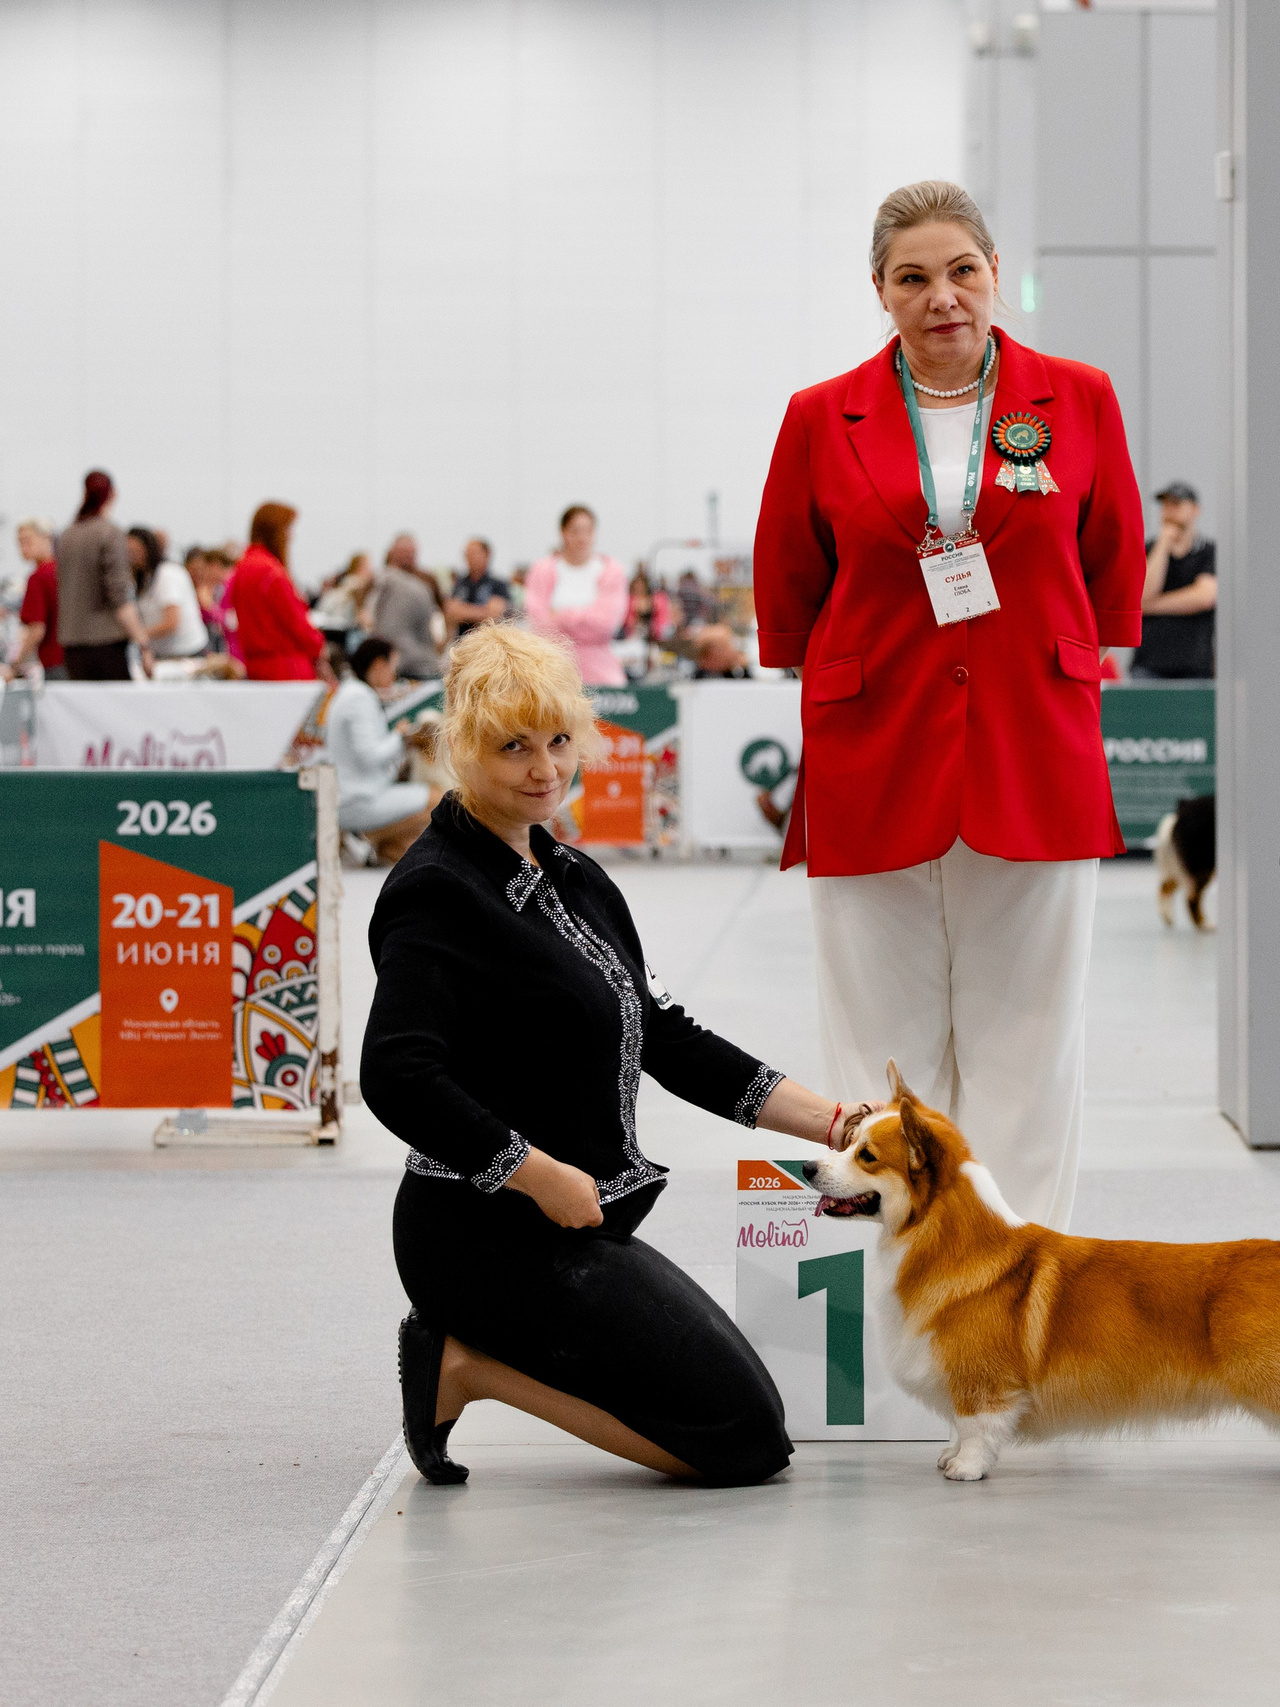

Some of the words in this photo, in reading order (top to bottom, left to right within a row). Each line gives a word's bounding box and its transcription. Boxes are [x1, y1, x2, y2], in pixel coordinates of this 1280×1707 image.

[941, 552, 963, 561] РОССИЯ
[945, 571, 972, 583] СУДЬЯ
[116, 800, 217, 836] 2026
[0, 888, 36, 928] Я
[112, 893, 220, 928] 20-21
[117, 941, 220, 965] ИЮНЯ
[749, 1177, 781, 1188] 2026
[737, 1219, 808, 1248] Molina
[798, 1249, 864, 1425] 1
